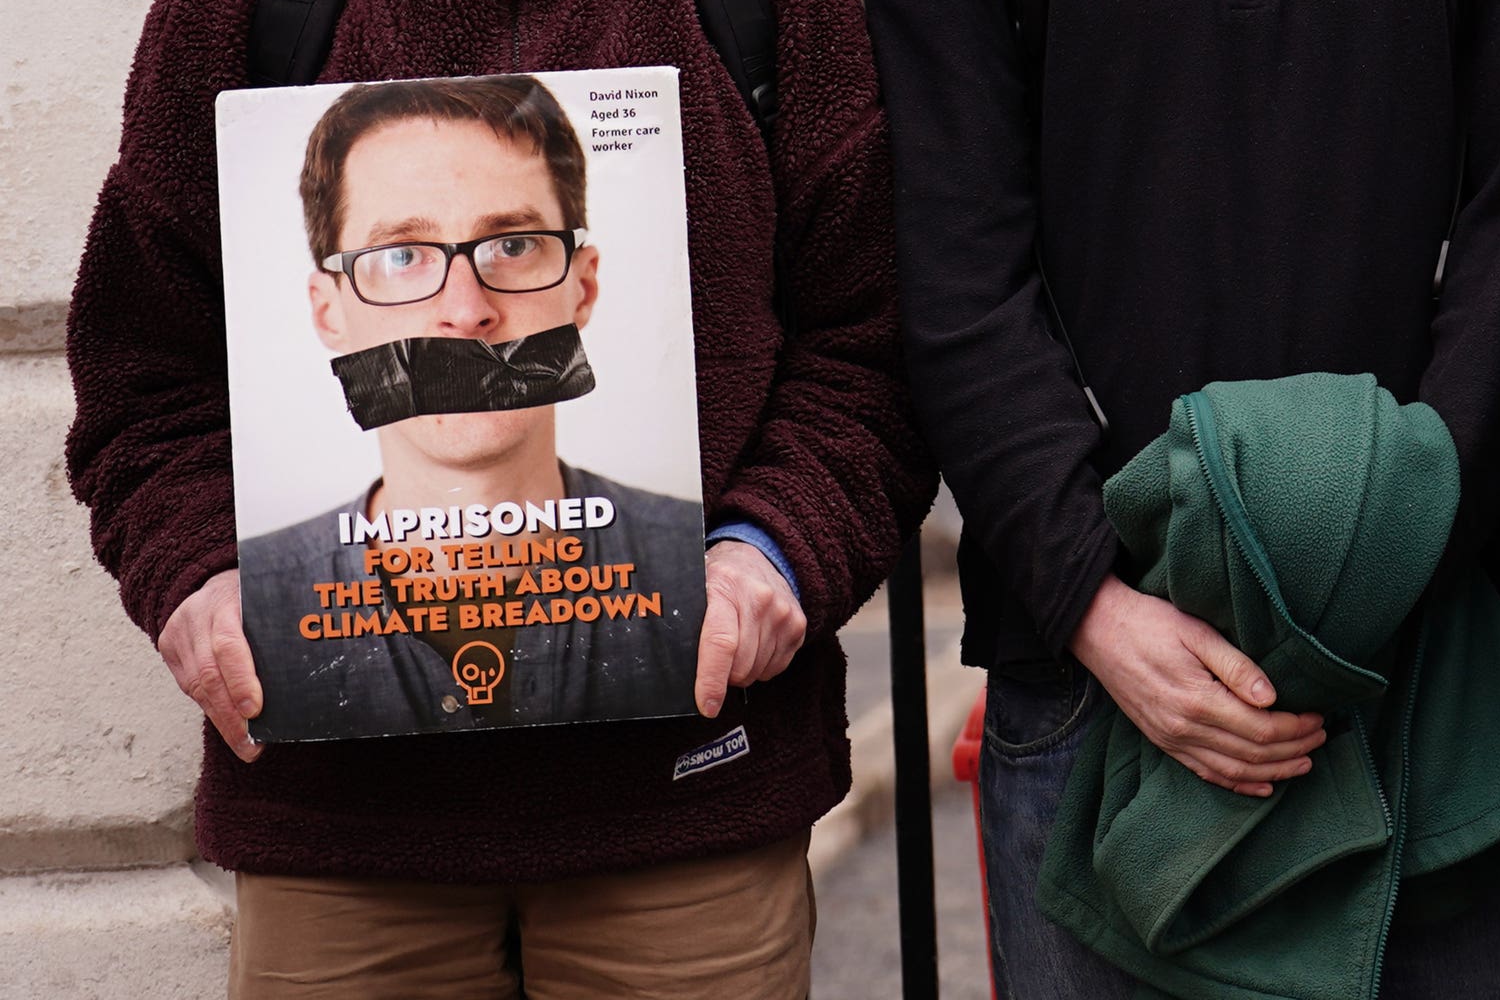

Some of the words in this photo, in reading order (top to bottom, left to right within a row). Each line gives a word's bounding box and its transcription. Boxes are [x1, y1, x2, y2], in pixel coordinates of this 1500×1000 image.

[589, 90, 622, 101] David
[625, 89, 658, 99] Nixon
[591, 108, 619, 121] Aged
[622, 108, 636, 118] 36
[592, 128, 633, 137] Former
[636, 126, 661, 135] care
[592, 141, 633, 152] worker
[338, 496, 616, 545] IMPRISONED
[363, 547, 434, 575] FOR
[441, 536, 584, 569] TELLING
[313, 582, 384, 608] THE
[391, 574, 505, 603] TRUTH
[515, 563, 636, 596] ABOUT
[299, 606, 449, 640] CLIMATE
[460, 592, 663, 630] BREADOWN
[689, 744, 724, 766] SNOW
[725, 734, 744, 753] TOP
